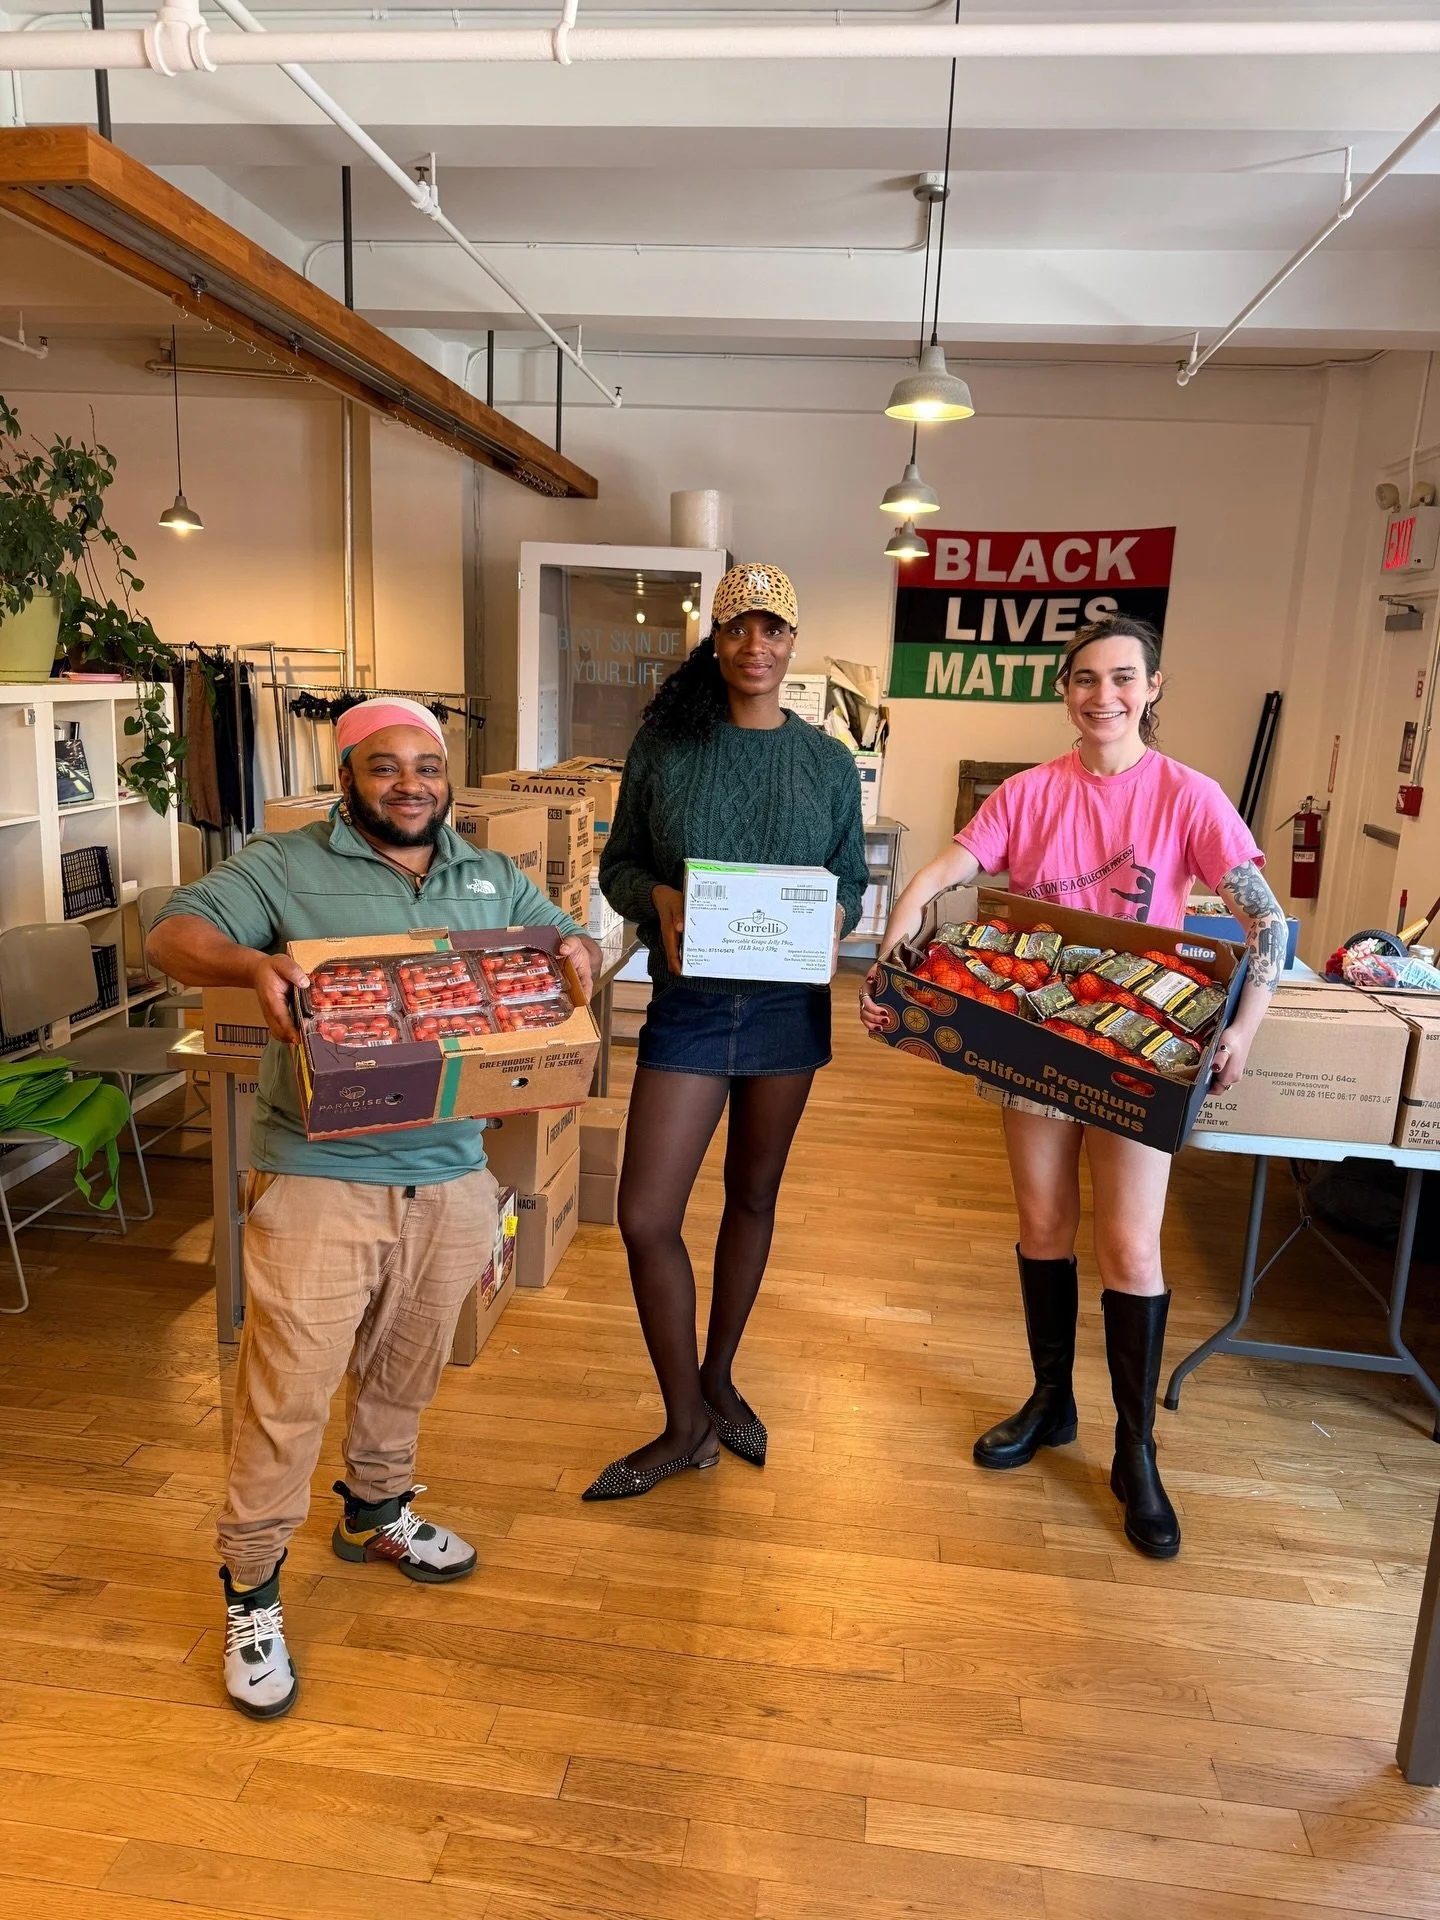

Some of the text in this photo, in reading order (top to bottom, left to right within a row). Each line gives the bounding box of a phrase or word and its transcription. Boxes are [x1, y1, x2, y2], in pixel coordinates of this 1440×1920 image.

[1384, 517, 1416, 569] EXIT
[934, 537, 1140, 583] BLACK
[747, 571, 770, 591] NY
[945, 597, 1118, 642] LIVES
[610, 629, 651, 655] SKIN
[658, 632, 681, 655] OF
[573, 660, 664, 685] YOUR LIFE
[925, 651, 1067, 697] MATT
[1416, 680, 1423, 698] B
[511, 784, 586, 797] BANANAS
[548, 810, 561, 819] 263
[1060, 881, 1069, 892] IS
[1070, 880, 1076, 890] A
[1077, 867, 1112, 888] COLLECTIVE
[1110, 848, 1133, 870] PROCESS
[736, 921, 780, 933] Forrelli
[480, 1056, 535, 1069] GREENHOUSE
[546, 1051, 580, 1061] CULTIVÉ
[557, 1058, 584, 1067] SERRE
[502, 1064, 533, 1073] GROWN
[1256, 1069, 1293, 1080] Squeeze
[1295, 1071, 1318, 1080] Prem
[1336, 1074, 1357, 1083] 64oz
[964, 1050, 1144, 1132] California Citrus
[1042, 1065, 1146, 1119] Premium
[319, 1098, 382, 1111] PARADISE
[1337, 1093, 1356, 1101] 06:17
[1360, 1094, 1381, 1103] 00573
[1383, 1096, 1392, 1104] JF
[1411, 1119, 1430, 1129] 8/64
[1421, 1130, 1430, 1138] lb
